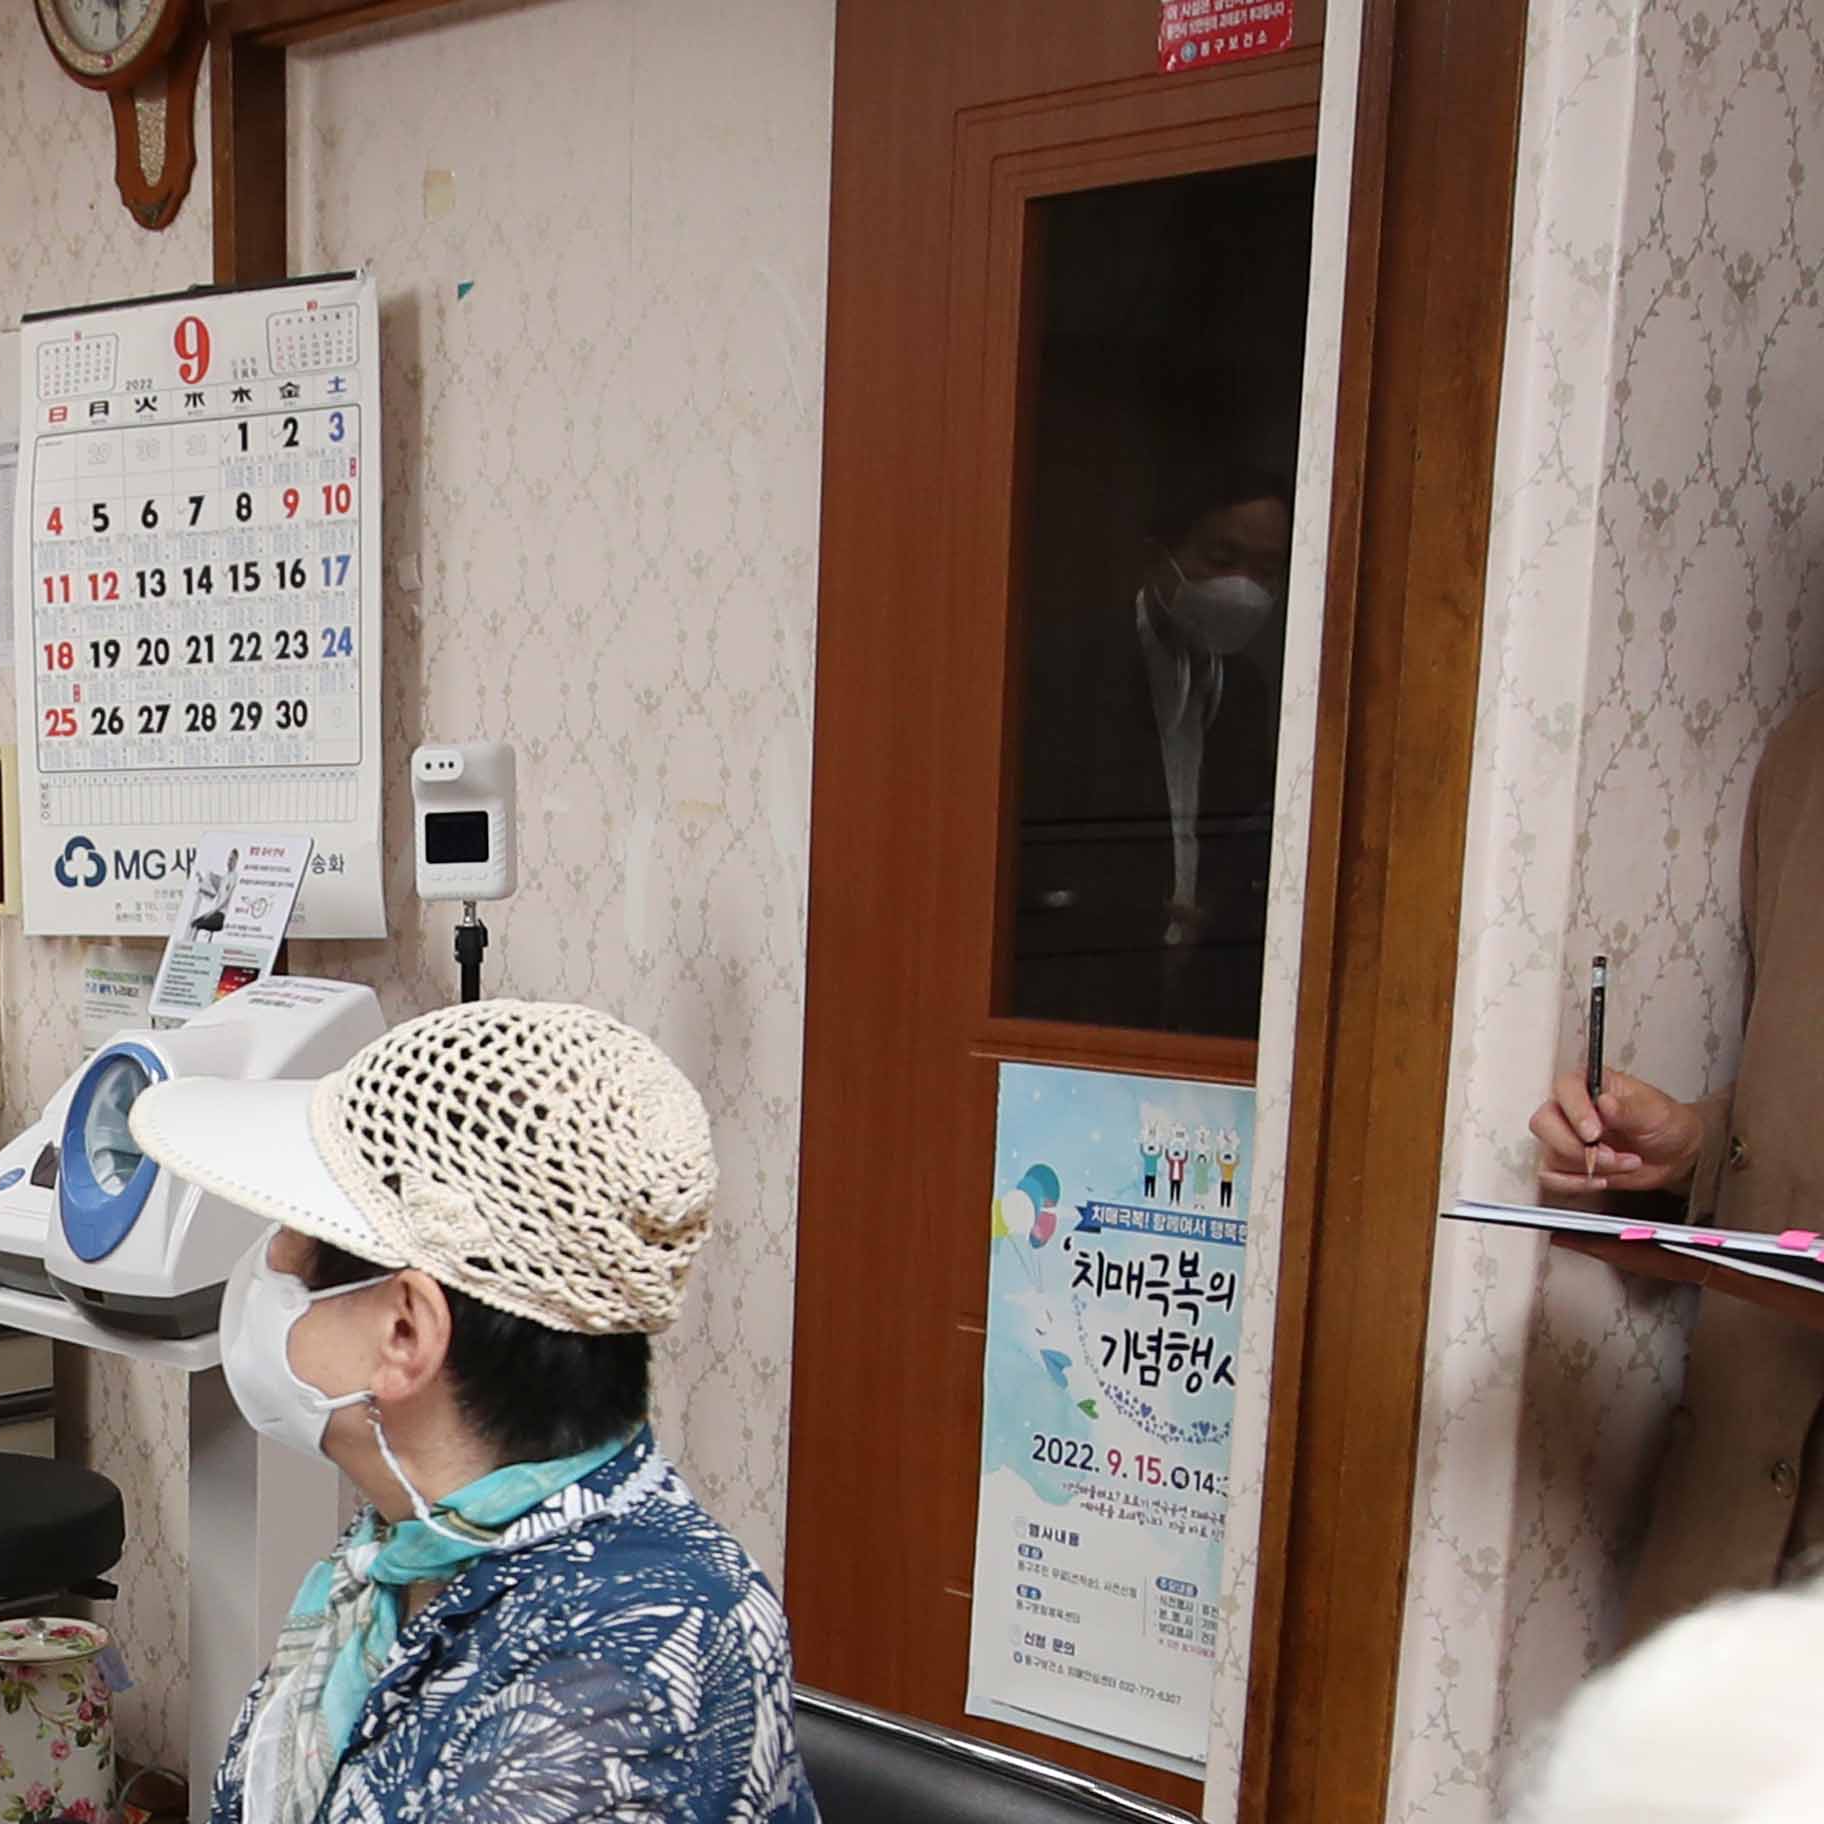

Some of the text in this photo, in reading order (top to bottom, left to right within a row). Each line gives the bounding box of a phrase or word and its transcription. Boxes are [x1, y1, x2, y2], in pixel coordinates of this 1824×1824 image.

[174, 316, 210, 384] 9
[49, 407, 67, 423] 日
[89, 401, 109, 417] 月
[135, 396, 157, 413] 火
[280, 382, 300, 399] 金
[327, 376, 347, 393] 土
[126, 379, 152, 391] 2022
[238, 422, 248, 451] 1
[283, 417, 299, 448] 2
[330, 412, 344, 441] 3
[47, 484, 351, 535] 4 5 6 7 8 9 10
[44, 555, 350, 603] 11 12 13 14 15 16 17
[44, 627, 352, 670] 18 19 20 21 22 23 24
[45, 699, 308, 736] 25 26 27 28 29 30
[114, 847, 197, 880] MG새
[1091, 1205, 1150, 1229] 치매극복!
[1152, 1213, 1206, 1236] 함께여서
[1032, 1434, 1100, 1473] 2022.
[1107, 1448, 1127, 1479] 9.
[1135, 1454, 1167, 1487] 15.
